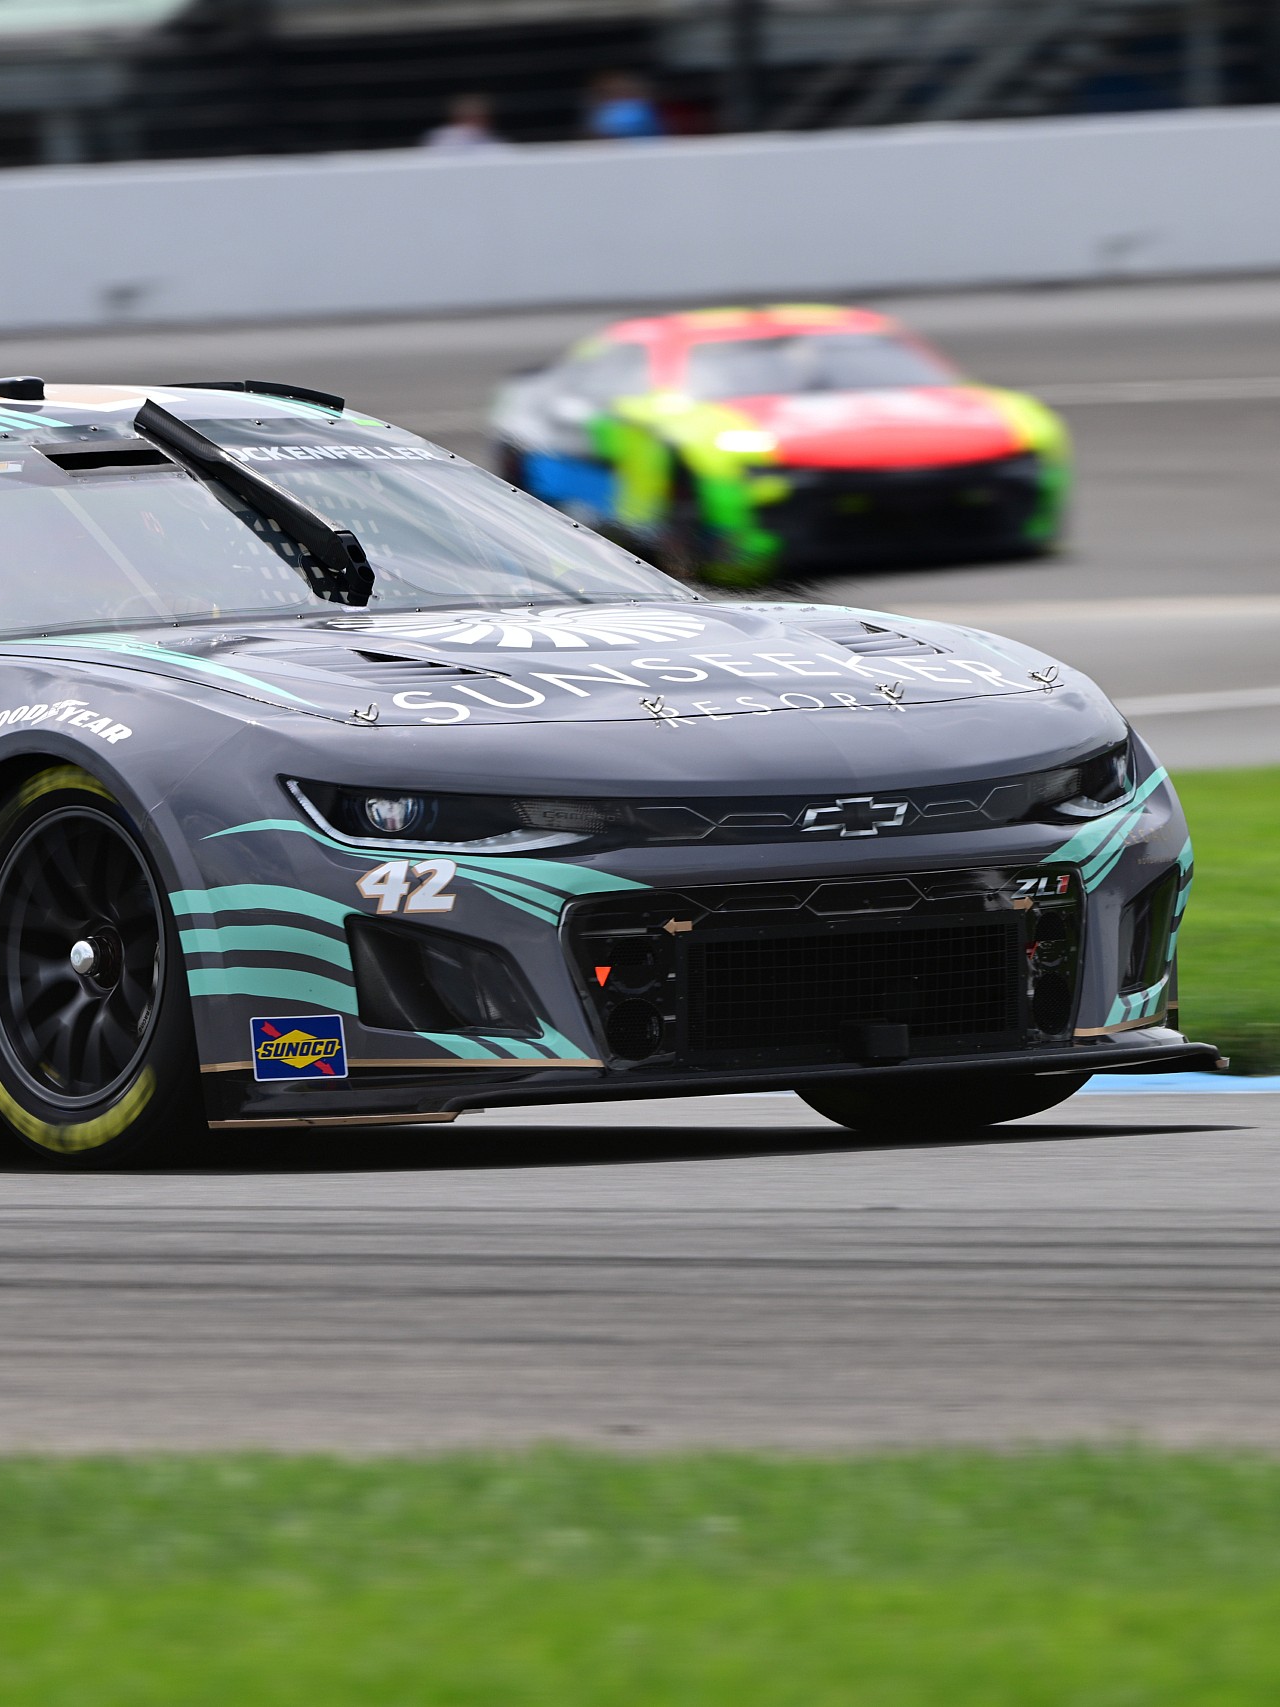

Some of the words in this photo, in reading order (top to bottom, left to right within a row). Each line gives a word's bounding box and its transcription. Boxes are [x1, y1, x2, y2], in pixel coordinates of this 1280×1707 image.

[221, 446, 445, 461] OCKENFELLER
[391, 651, 1037, 725] SUNSEEKER
[657, 692, 907, 729] RESORT
[356, 858, 458, 914] 42
[1010, 875, 1070, 899] ZL1
[260, 1038, 338, 1060] SUNOCO
